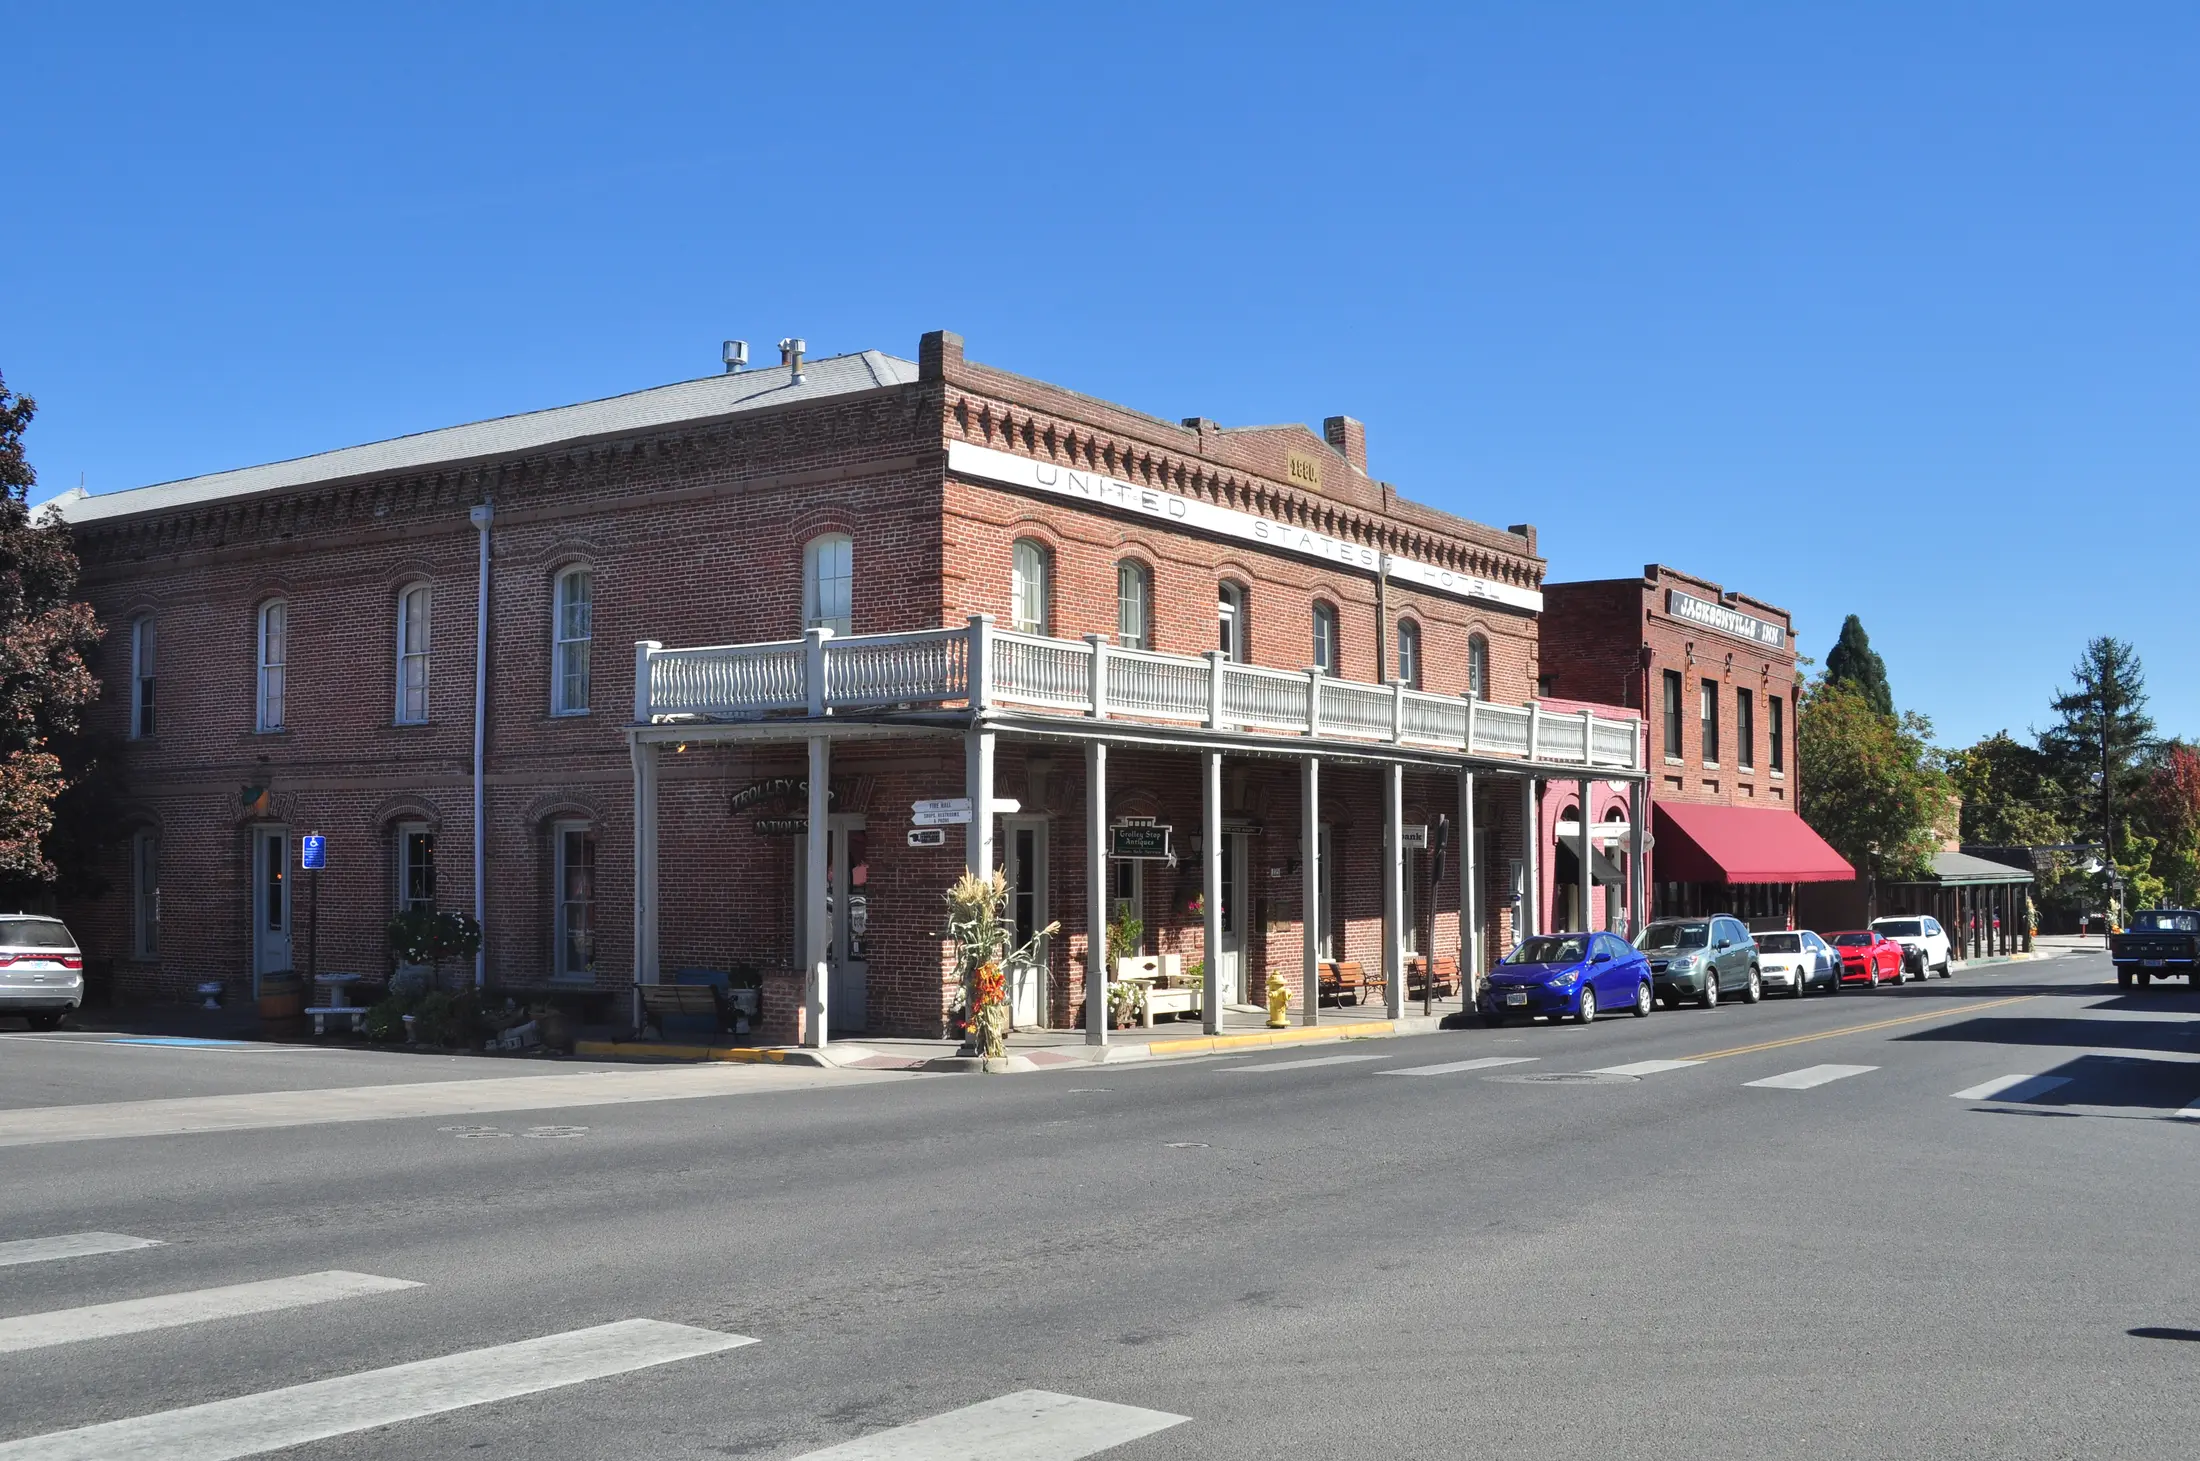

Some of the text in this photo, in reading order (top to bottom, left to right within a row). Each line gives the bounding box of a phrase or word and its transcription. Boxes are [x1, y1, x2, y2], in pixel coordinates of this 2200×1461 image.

[1036, 463, 1500, 600] UNITED STATES HOTEL
[1761, 624, 1779, 645] INN
[732, 779, 794, 809] TROLLEY
